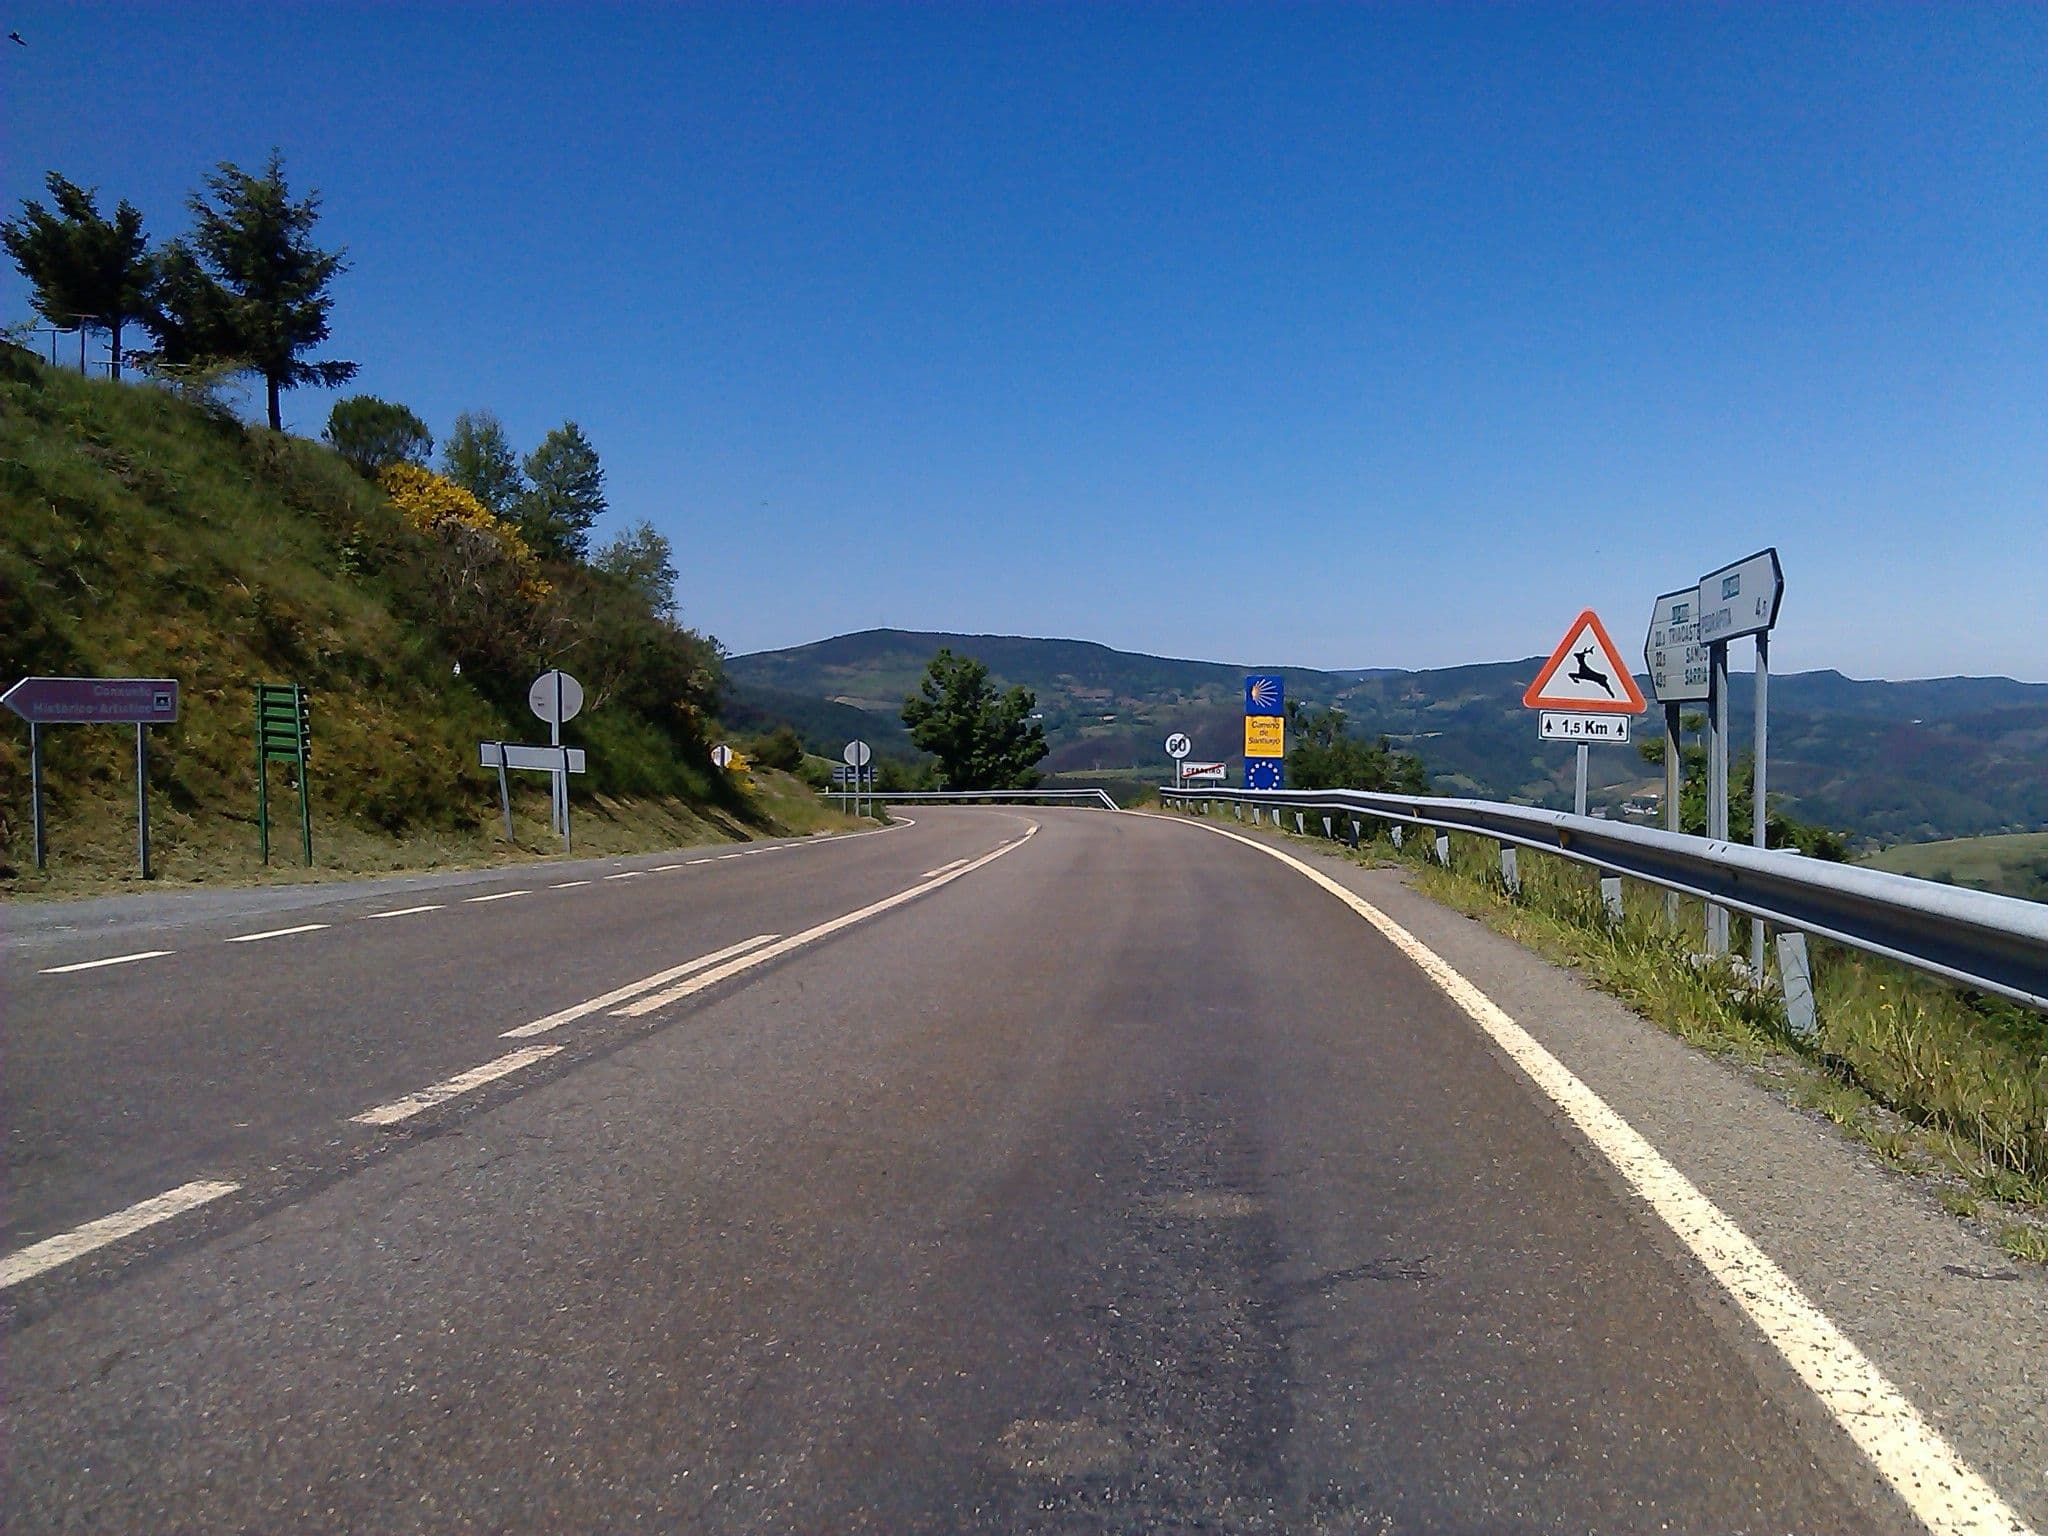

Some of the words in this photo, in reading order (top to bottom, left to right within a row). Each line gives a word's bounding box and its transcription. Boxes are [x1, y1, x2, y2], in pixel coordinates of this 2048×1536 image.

[1585, 720, 1608, 735] Km
[1169, 738, 1187, 753] 60
[1248, 736, 1281, 747] Santiago
